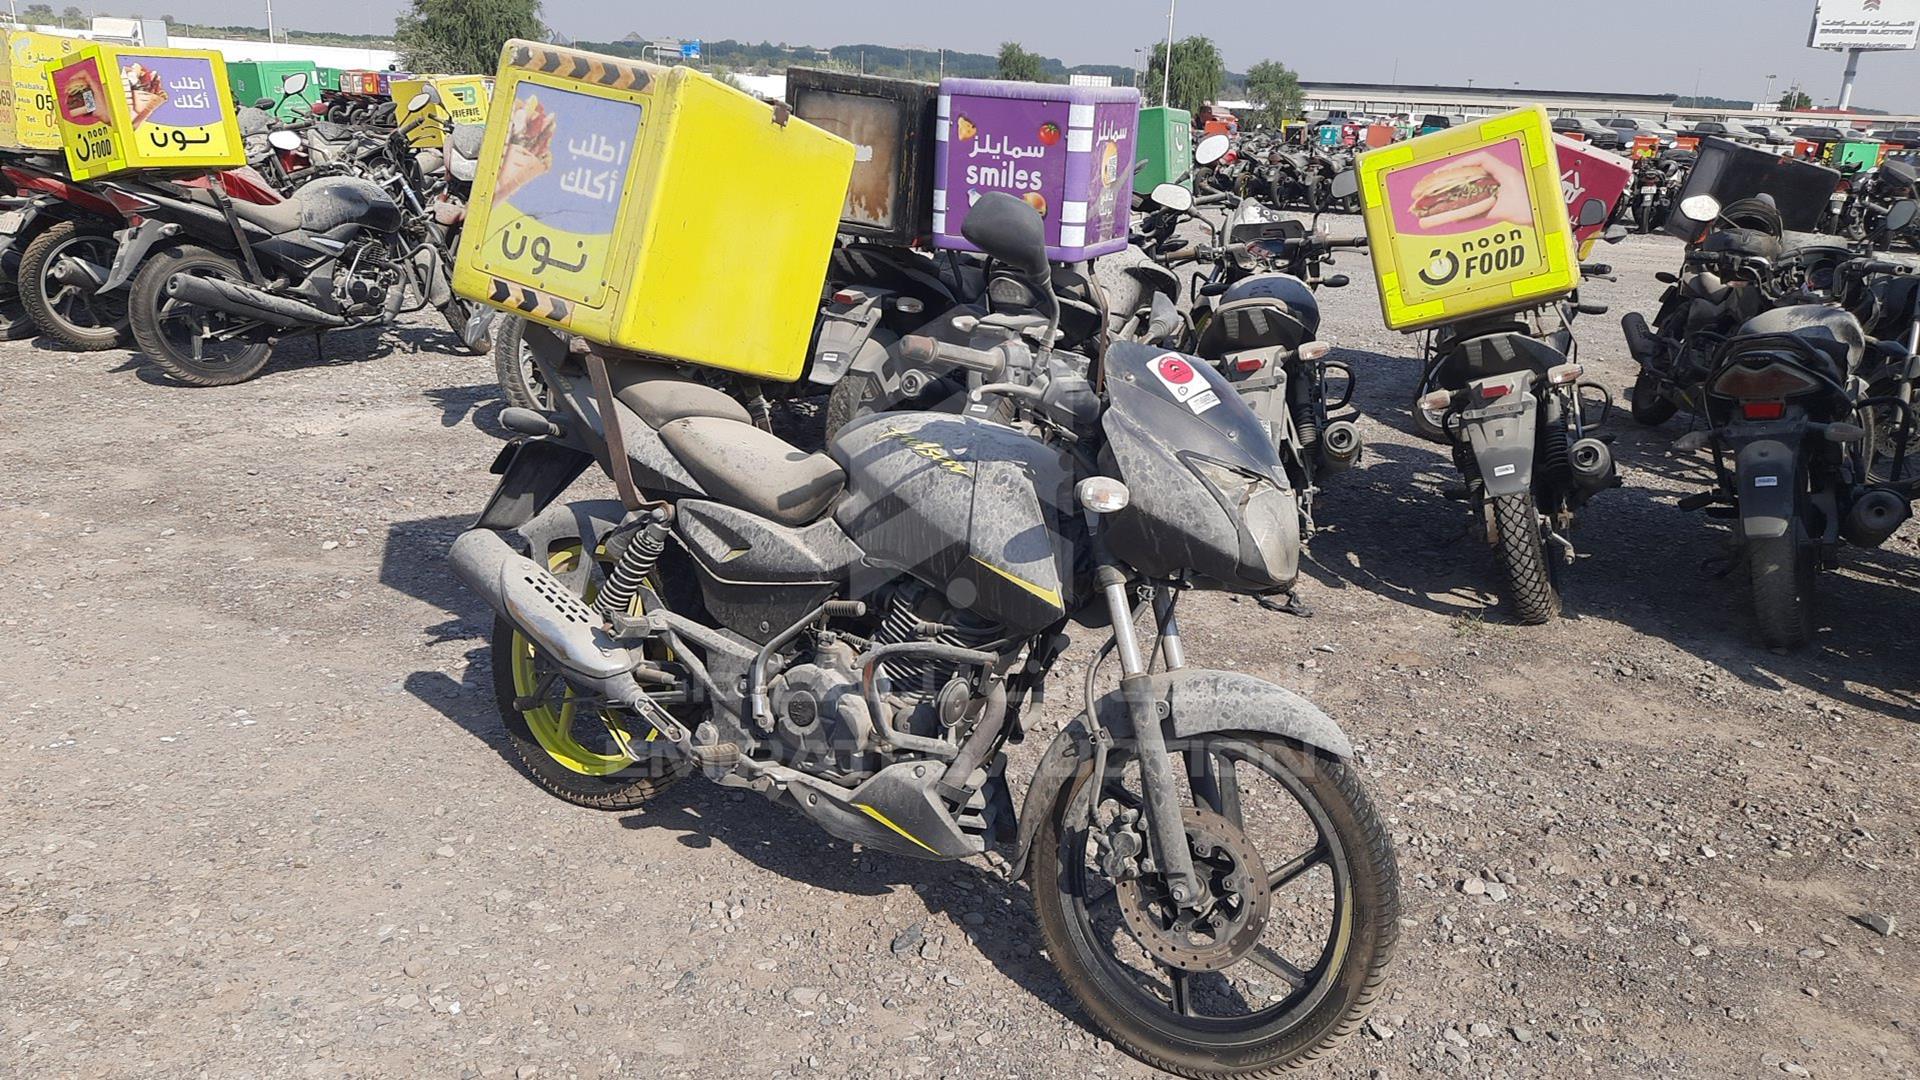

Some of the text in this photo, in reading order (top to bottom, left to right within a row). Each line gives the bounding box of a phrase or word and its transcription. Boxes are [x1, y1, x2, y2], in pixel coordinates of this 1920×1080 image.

[169, 76, 206, 92] اطلب
[173, 92, 210, 109] أكلك
[87, 126, 109, 139] noon
[150, 126, 210, 151] نون
[91, 139, 112, 160] FOOD
[568, 133, 626, 166] اطلب
[968, 134, 1045, 159] سمايلز
[560, 167, 619, 204] أكلك
[966, 160, 1043, 191] smiles
[501, 222, 588, 275] نون
[1462, 229, 1522, 253] noon
[1465, 245, 1525, 279] FOOD
